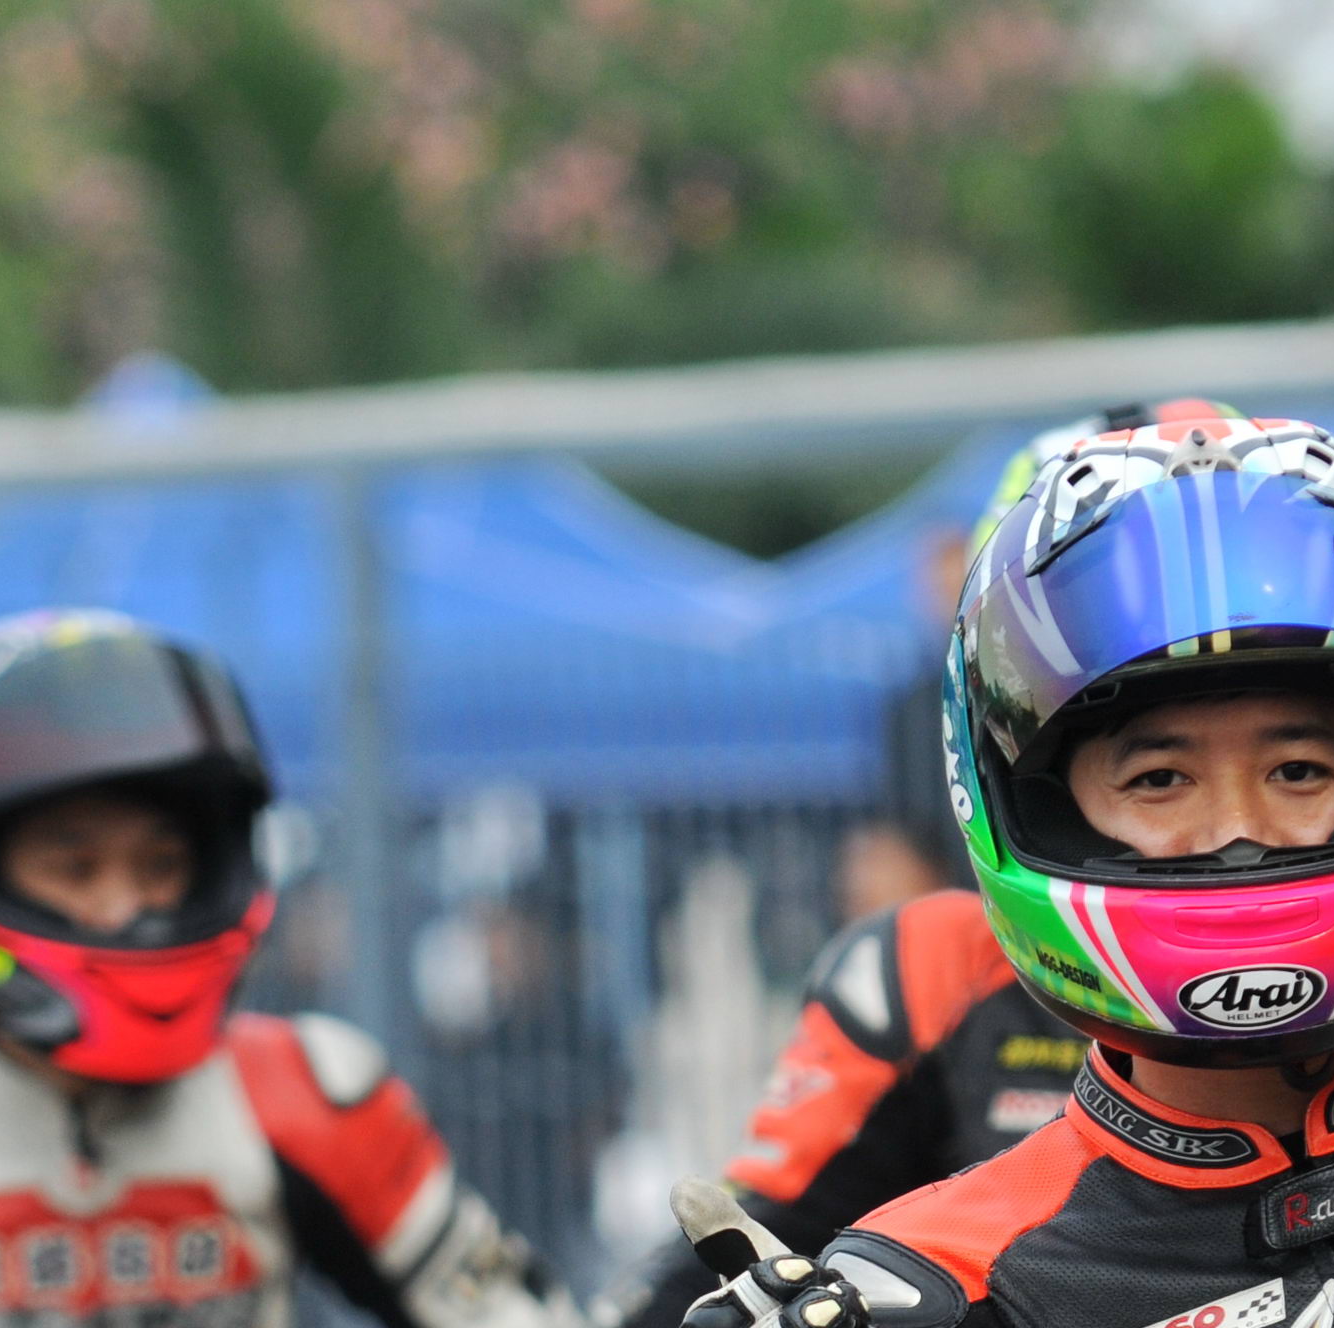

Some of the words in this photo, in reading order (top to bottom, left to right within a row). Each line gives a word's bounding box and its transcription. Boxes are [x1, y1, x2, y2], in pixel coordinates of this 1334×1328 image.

[1188, 969, 1307, 1011] Arai
[1226, 1009, 1281, 1021] HELMET
[1074, 1066, 1138, 1133] RACING
